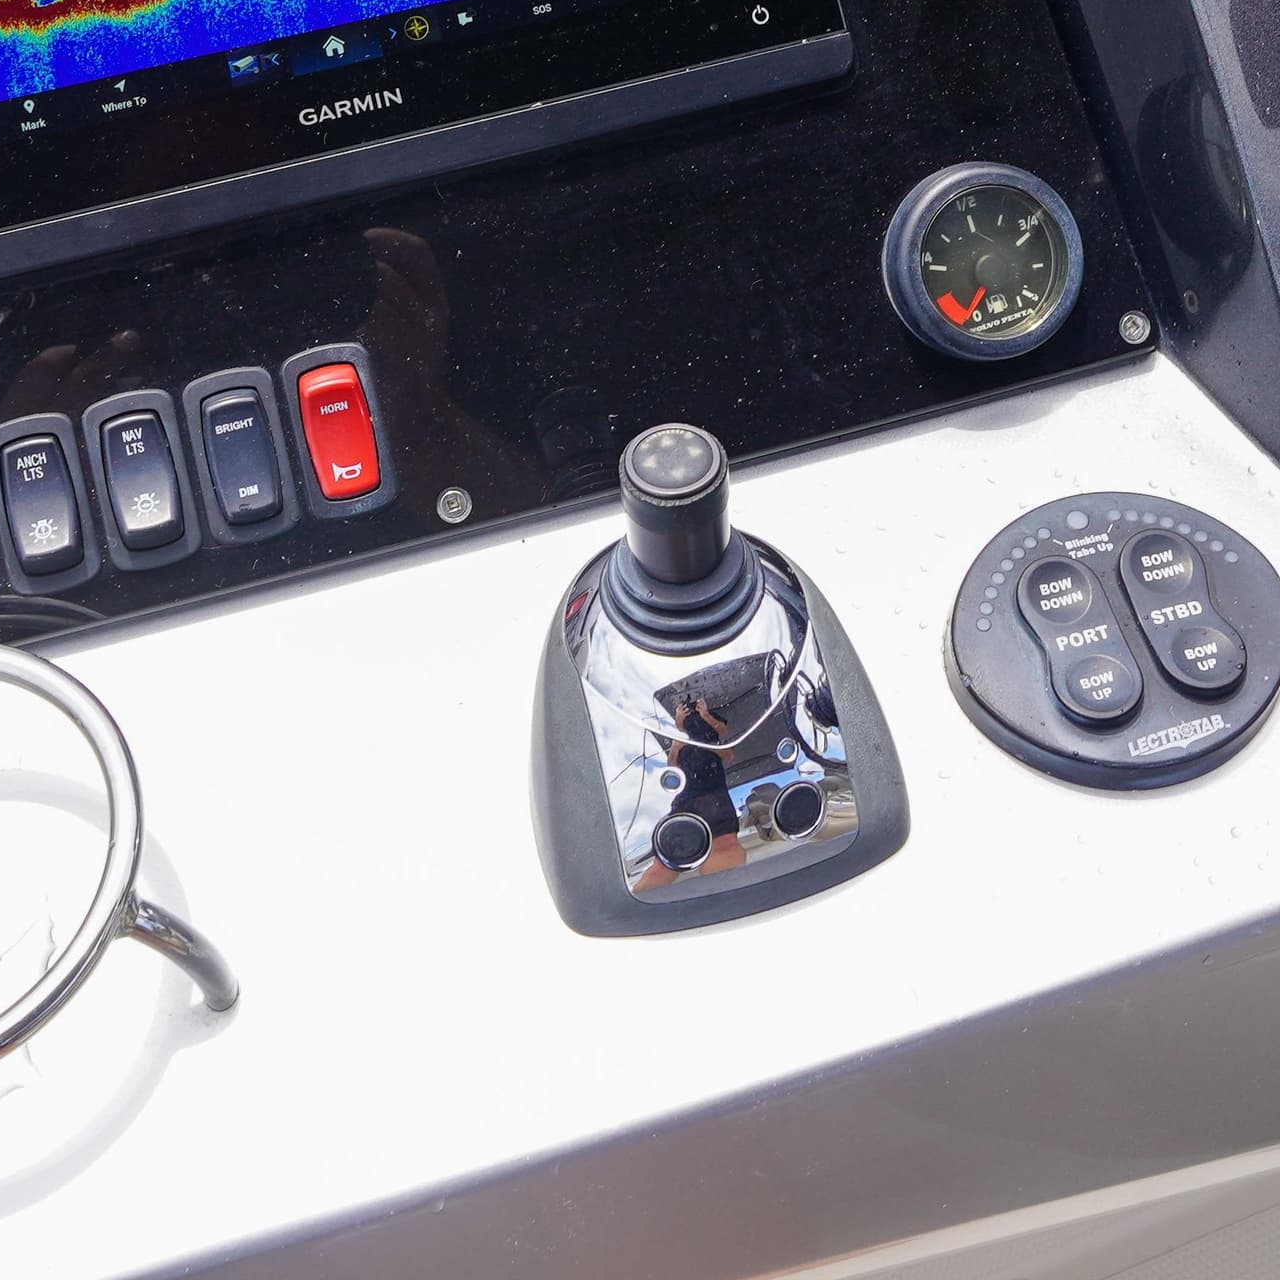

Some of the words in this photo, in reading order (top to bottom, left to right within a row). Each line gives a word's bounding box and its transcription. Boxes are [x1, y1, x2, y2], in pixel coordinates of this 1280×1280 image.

[532, 3, 552, 15] SOS
[102, 99, 133, 114] Where
[133, 96, 147, 107] To
[299, 87, 403, 126] GARMIN
[21, 118, 47, 132] Mark
[956, 195, 977, 213] 1/2
[1018, 214, 1039, 232] 3/4
[970, 319, 1001, 332] VOLVO
[1001, 308, 1035, 324] PENTA
[972, 309, 982, 322] 0
[320, 400, 348, 415] HORN
[122, 427, 143, 443] NAV
[215, 417, 254, 435] BRIGHT
[126, 440, 145, 456] LTS
[16, 452, 47, 470] ANCH
[23, 467, 44, 482] LTS
[239, 484, 259, 498] DIM
[1064, 533, 1109, 550] Blinking
[1068, 547, 1096, 559] Tabs
[1097, 542, 1114, 552] Up
[1141, 549, 1173, 568] BOW
[1143, 563, 1184, 582] DOWN
[1039, 576, 1072, 596] BOW
[1040, 590, 1083, 611] DOWN
[1151, 600, 1203, 625] STBD
[1056, 624, 1108, 651] PORT
[1184, 642, 1218, 660] BOW
[1197, 657, 1217, 671] UP
[1080, 670, 1114, 690] BOW
[1093, 686, 1113, 701] UP
